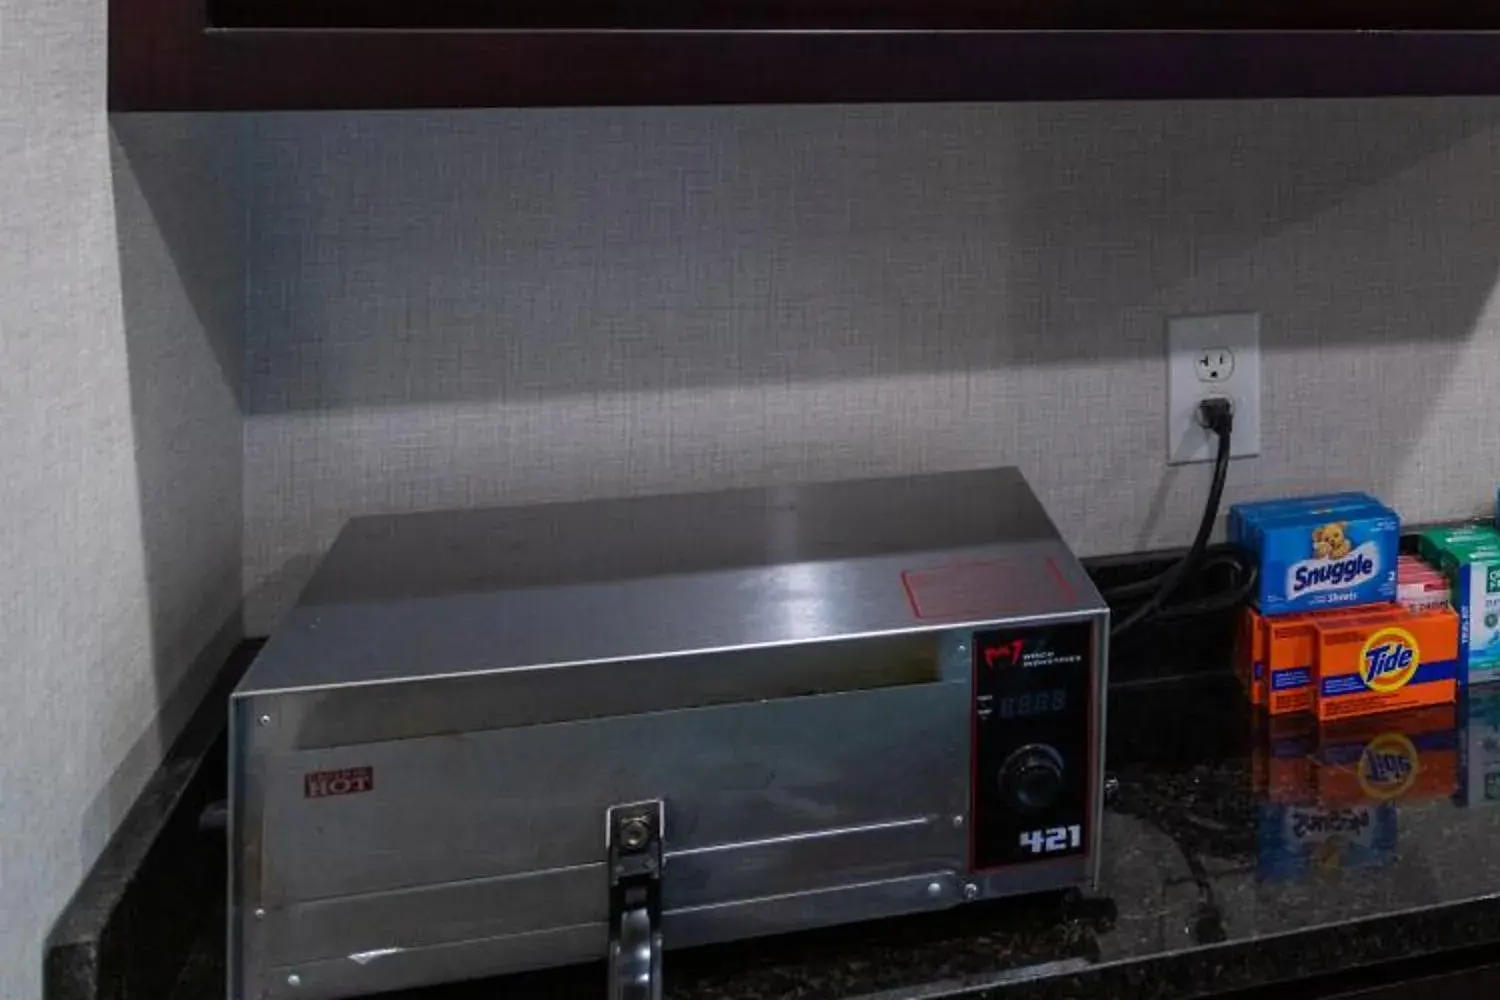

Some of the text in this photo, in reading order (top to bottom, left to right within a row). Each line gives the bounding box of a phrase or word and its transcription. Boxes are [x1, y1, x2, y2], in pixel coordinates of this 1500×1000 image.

[1293, 553, 1373, 592] Snuggle
[1365, 643, 1413, 682] Tide
[309, 776, 371, 798] HOT
[1019, 823, 1081, 854] 421
